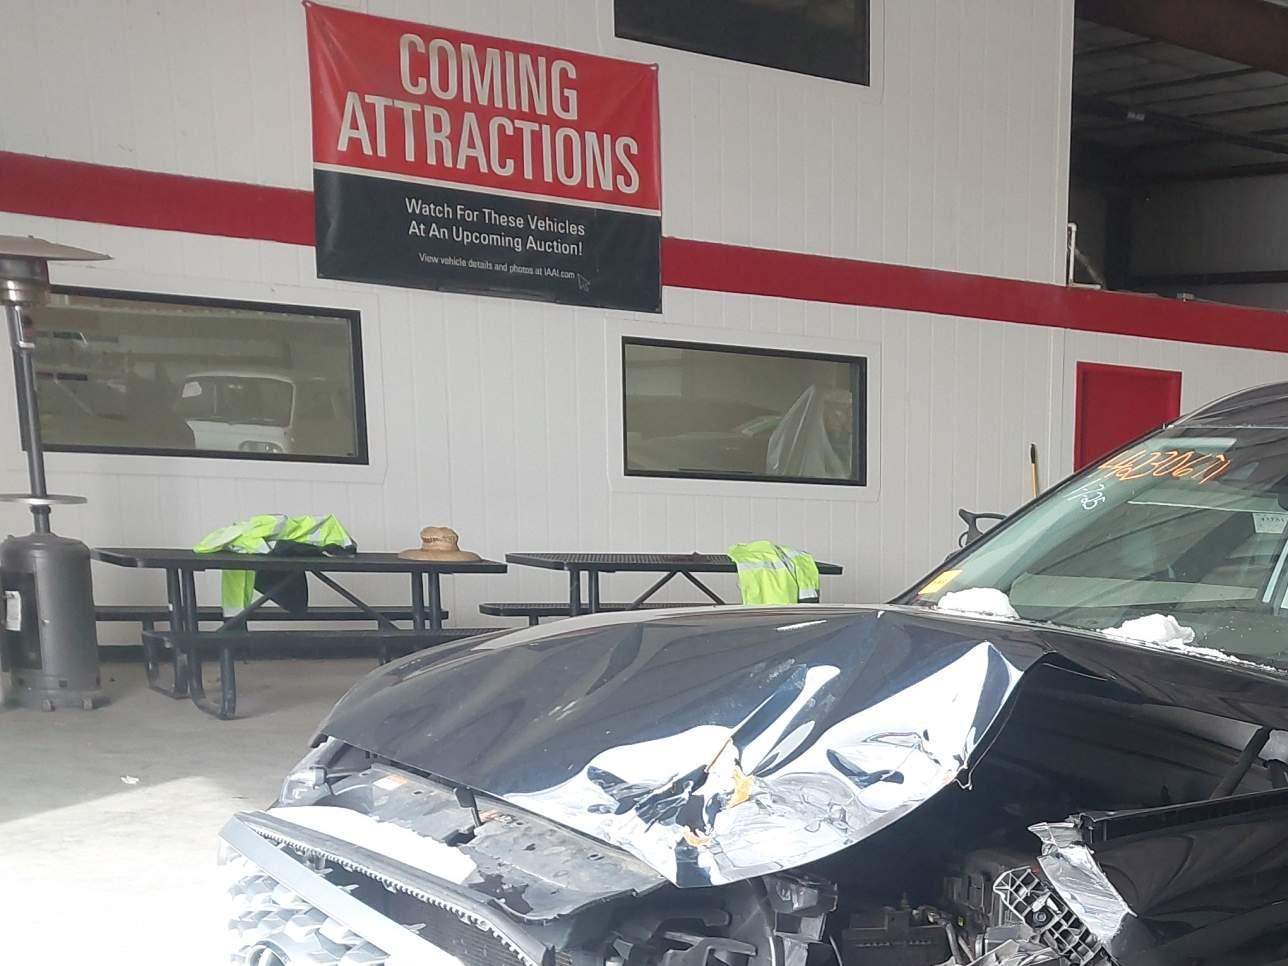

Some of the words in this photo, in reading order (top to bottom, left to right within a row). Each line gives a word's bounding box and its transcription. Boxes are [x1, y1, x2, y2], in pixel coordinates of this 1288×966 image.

[400, 33, 578, 120] COMING
[337, 91, 640, 194] ATTRACTIONS
[405, 197, 453, 219] Watch
[456, 204, 479, 222] For
[482, 208, 524, 228] These
[528, 214, 585, 236] Vehicles
[408, 220, 425, 237] At
[429, 223, 448, 240] An
[452, 226, 522, 251] Upcoming
[526, 236, 583, 256] Auction!
[418, 252, 439, 264] View
[440, 256, 467, 267] vehicle
[468, 260, 493, 271] details
[494, 262, 508, 272] and
[509, 264, 533, 275] photos
[535, 266, 543, 275] at
[544, 267, 575, 279] IAAI.com
